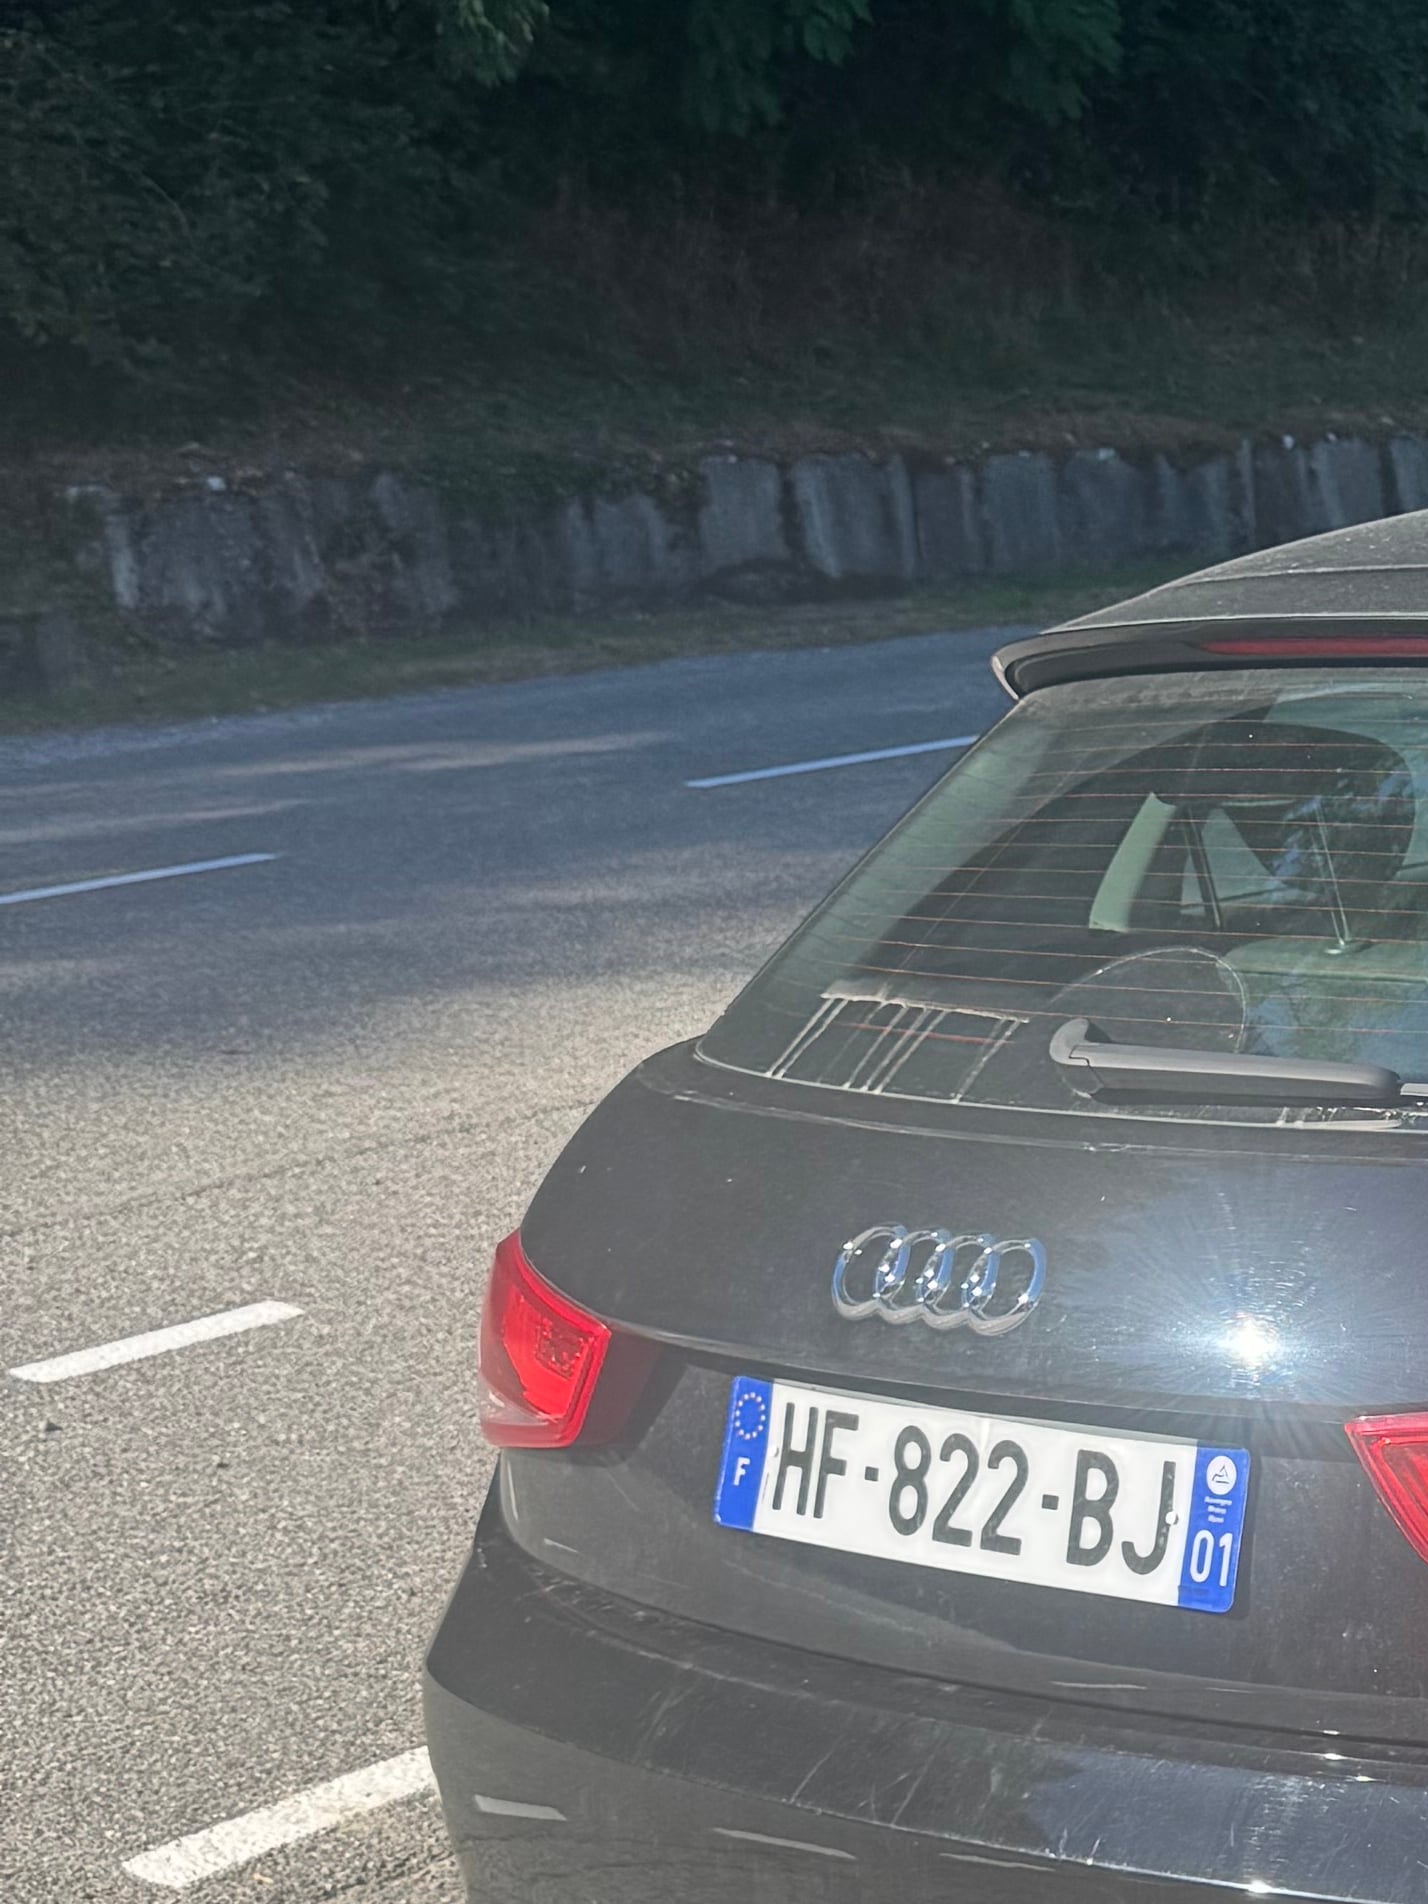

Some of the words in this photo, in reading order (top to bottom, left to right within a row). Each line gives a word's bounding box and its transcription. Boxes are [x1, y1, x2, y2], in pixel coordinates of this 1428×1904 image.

[732, 1457, 751, 1487] F
[771, 1402, 1177, 1576] HF-822-BJ
[1189, 1529, 1233, 1587] 01
